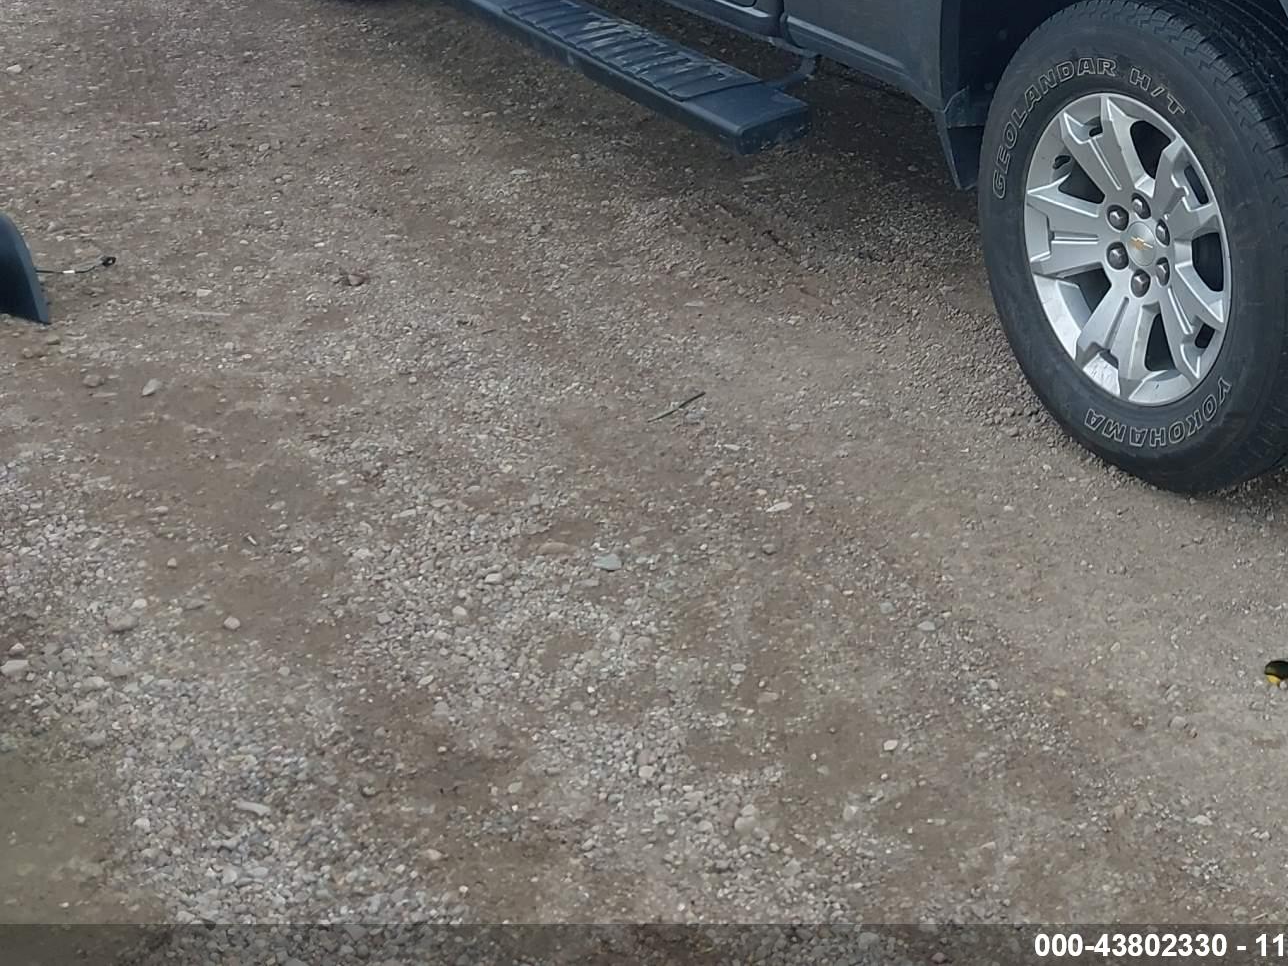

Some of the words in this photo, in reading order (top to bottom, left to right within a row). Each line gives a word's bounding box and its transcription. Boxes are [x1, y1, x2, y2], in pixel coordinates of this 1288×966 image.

[992, 57, 1117, 200] GEOLANDAR
[1129, 67, 1187, 117] H/T
[1084, 376, 1232, 447] YOKOHAMA
